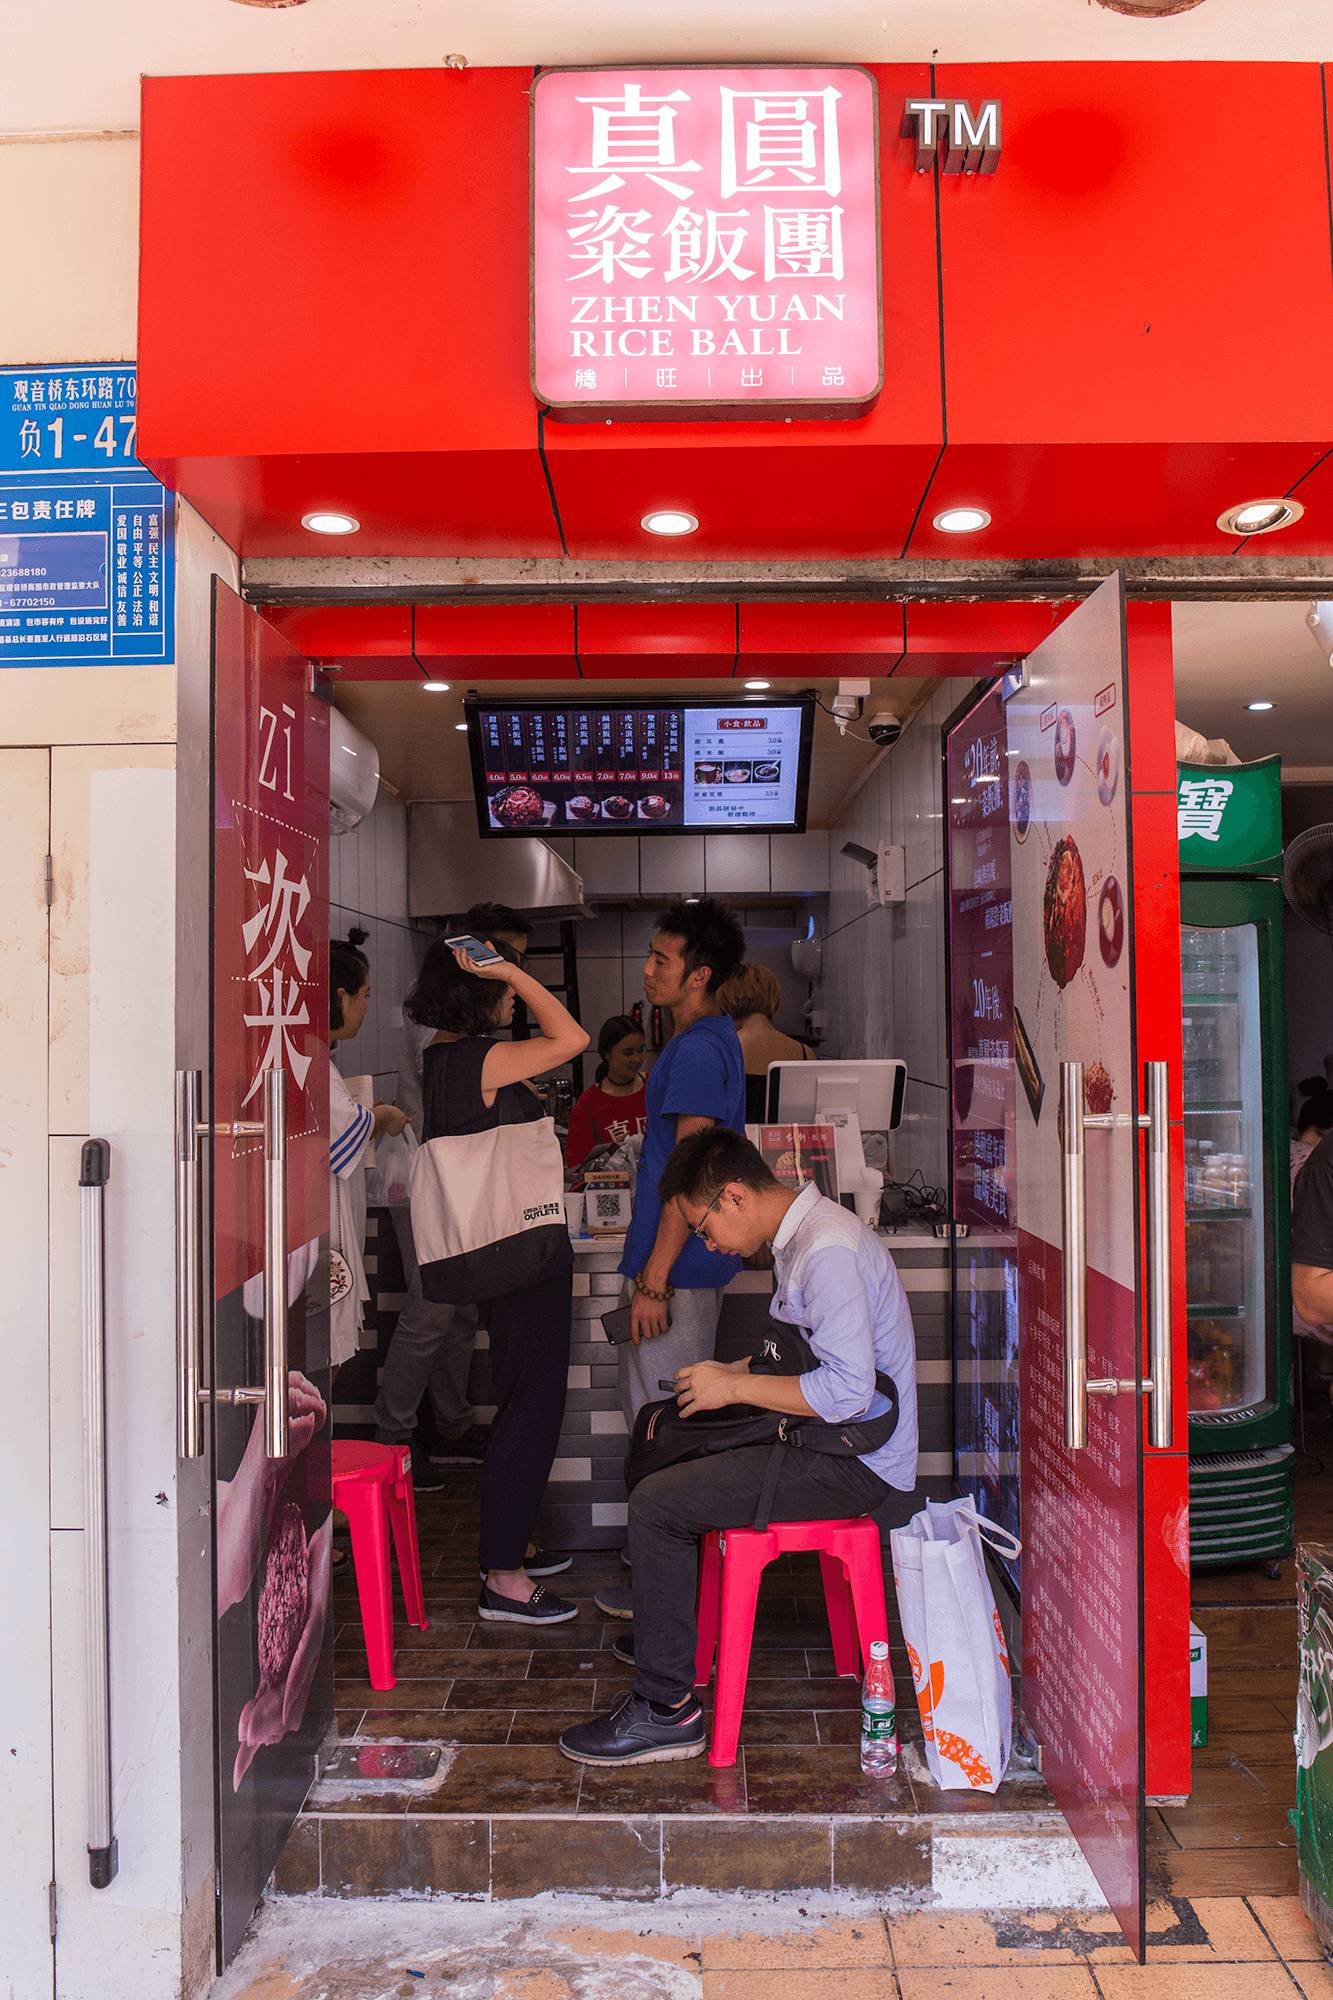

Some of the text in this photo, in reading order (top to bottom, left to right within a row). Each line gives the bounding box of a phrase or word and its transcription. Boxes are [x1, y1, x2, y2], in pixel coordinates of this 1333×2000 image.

[910, 101, 998, 147] TM
[564, 83, 843, 202] 真圓
[570, 294, 847, 324] ZHEN YUAN
[570, 327, 802, 357] RICE BALL
[11, 403, 32, 412] GUAN
[34, 403, 47, 411] YIN
[49, 402, 67, 411] QIAO
[69, 400, 90, 410] DONG
[92, 400, 112, 409] HUAN
[114, 400, 124, 409] LU
[1178, 779, 1234, 841] 寶
[524, 1208, 560, 1221] OUTLETS
